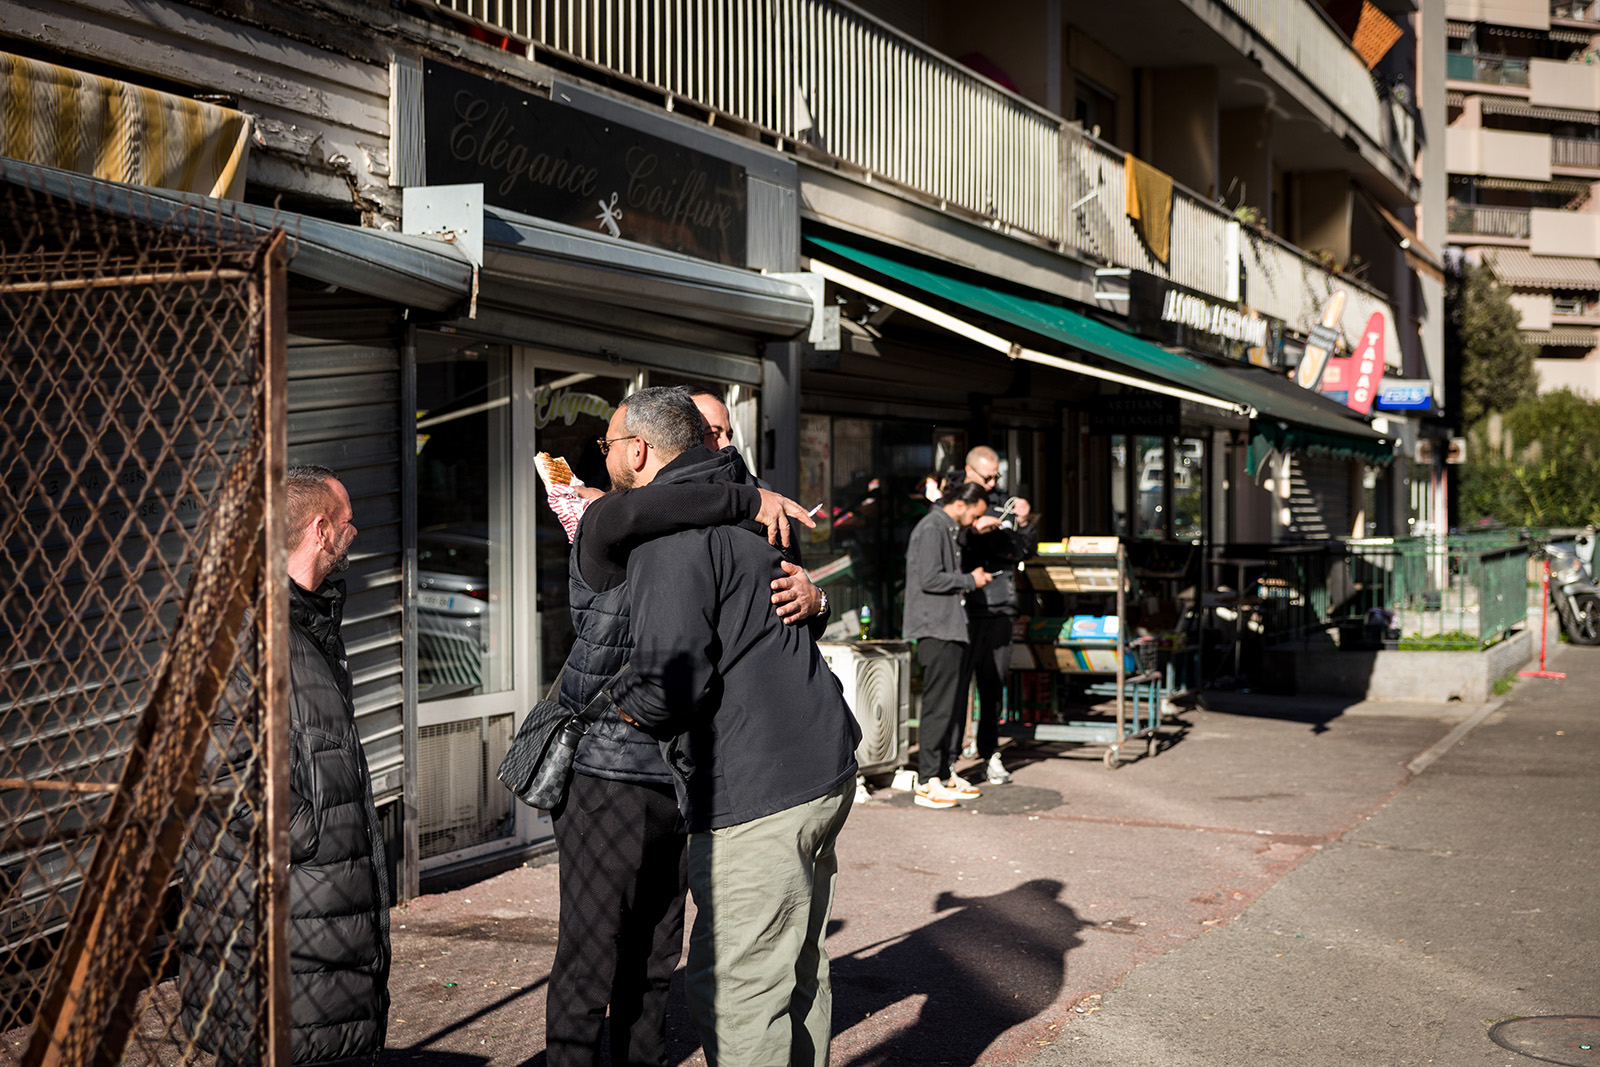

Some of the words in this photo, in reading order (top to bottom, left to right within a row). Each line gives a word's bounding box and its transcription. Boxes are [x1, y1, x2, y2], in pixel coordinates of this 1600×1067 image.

[449, 88, 599, 197] Elégance
[625, 144, 732, 235] Coiffure
[1354, 332, 1381, 403] TABAC
[1094, 414, 1176, 426] BOULANGER
[1107, 399, 1164, 410] ARTISAN
